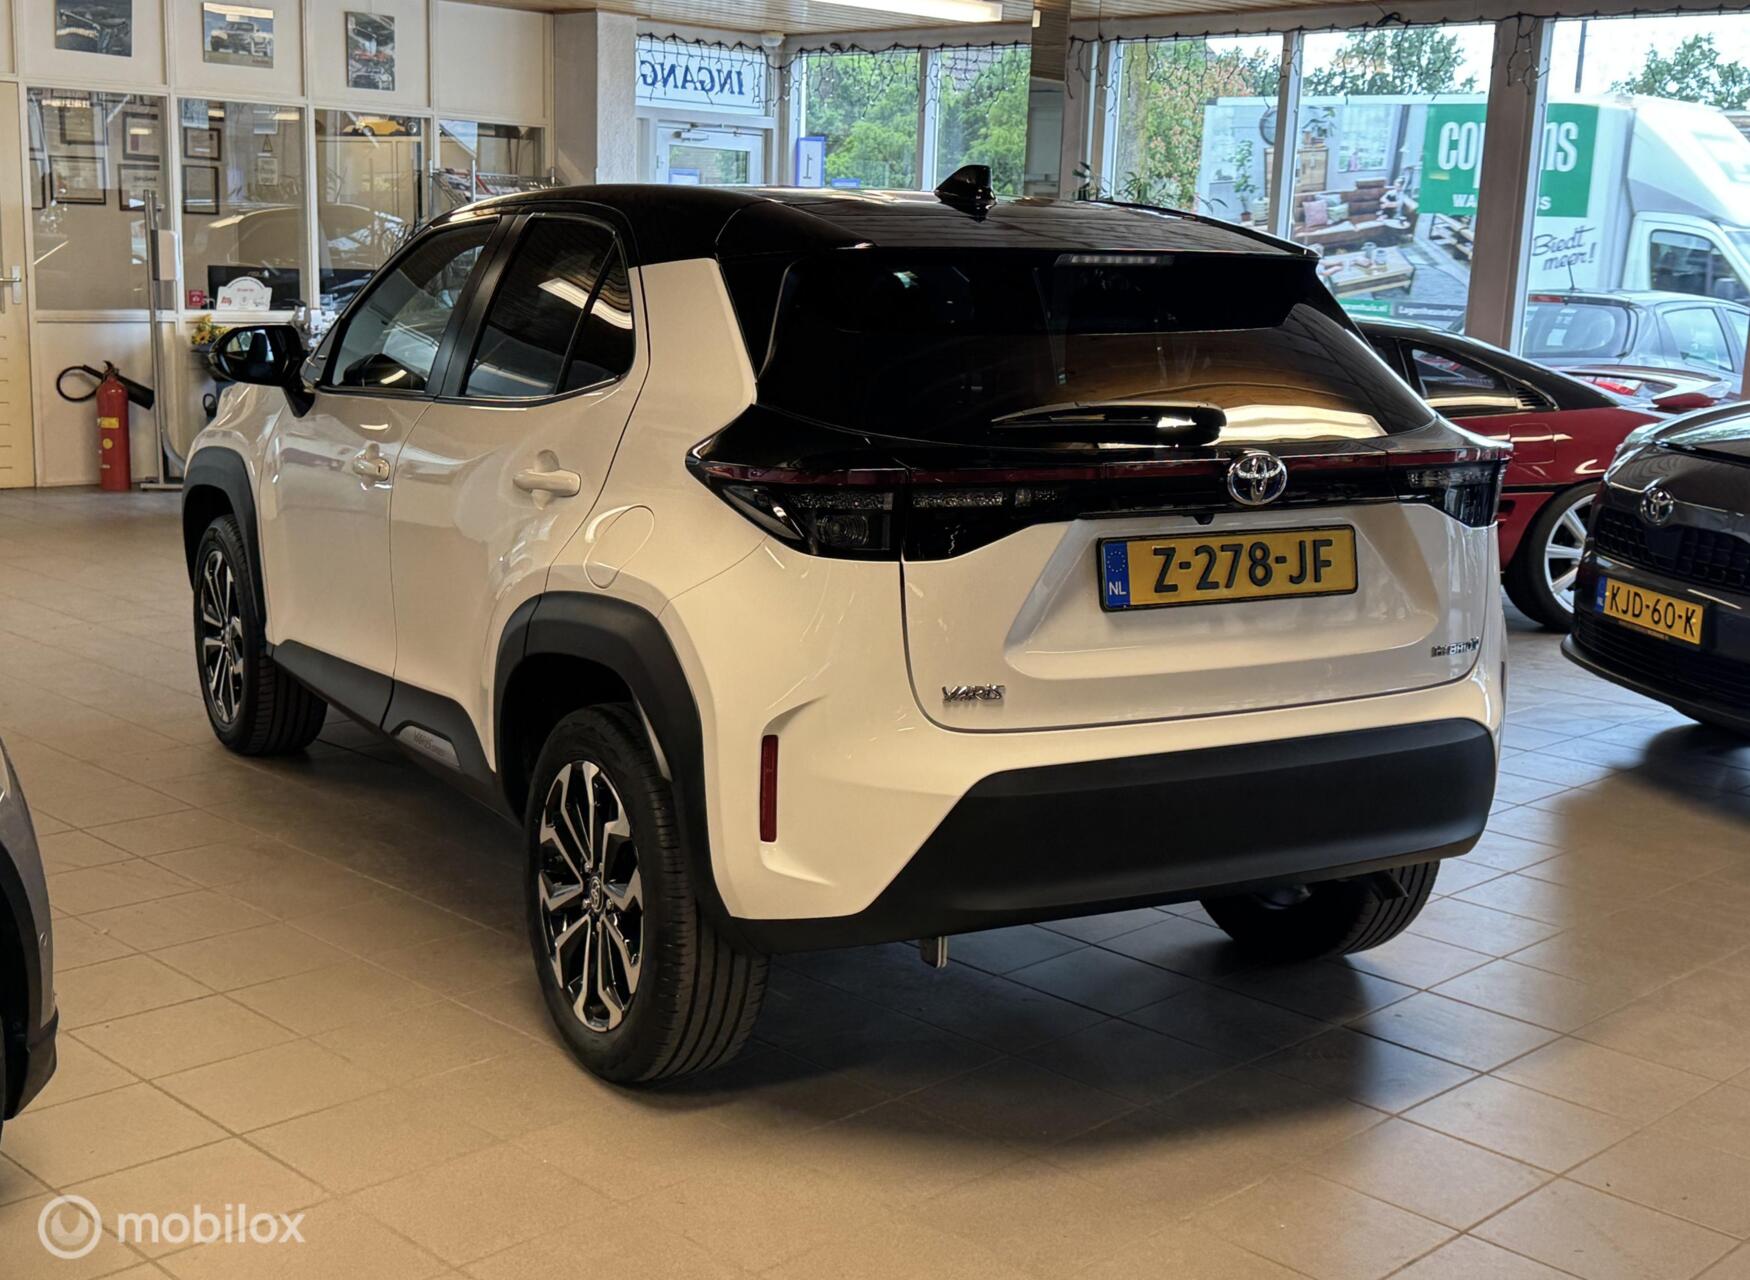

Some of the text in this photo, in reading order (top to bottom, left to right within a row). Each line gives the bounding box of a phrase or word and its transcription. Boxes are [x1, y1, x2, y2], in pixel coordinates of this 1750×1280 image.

[1109, 581, 1127, 596] NL
[1152, 538, 1334, 594] Z-278-JF
[1608, 584, 1697, 637] KJD-60-K
